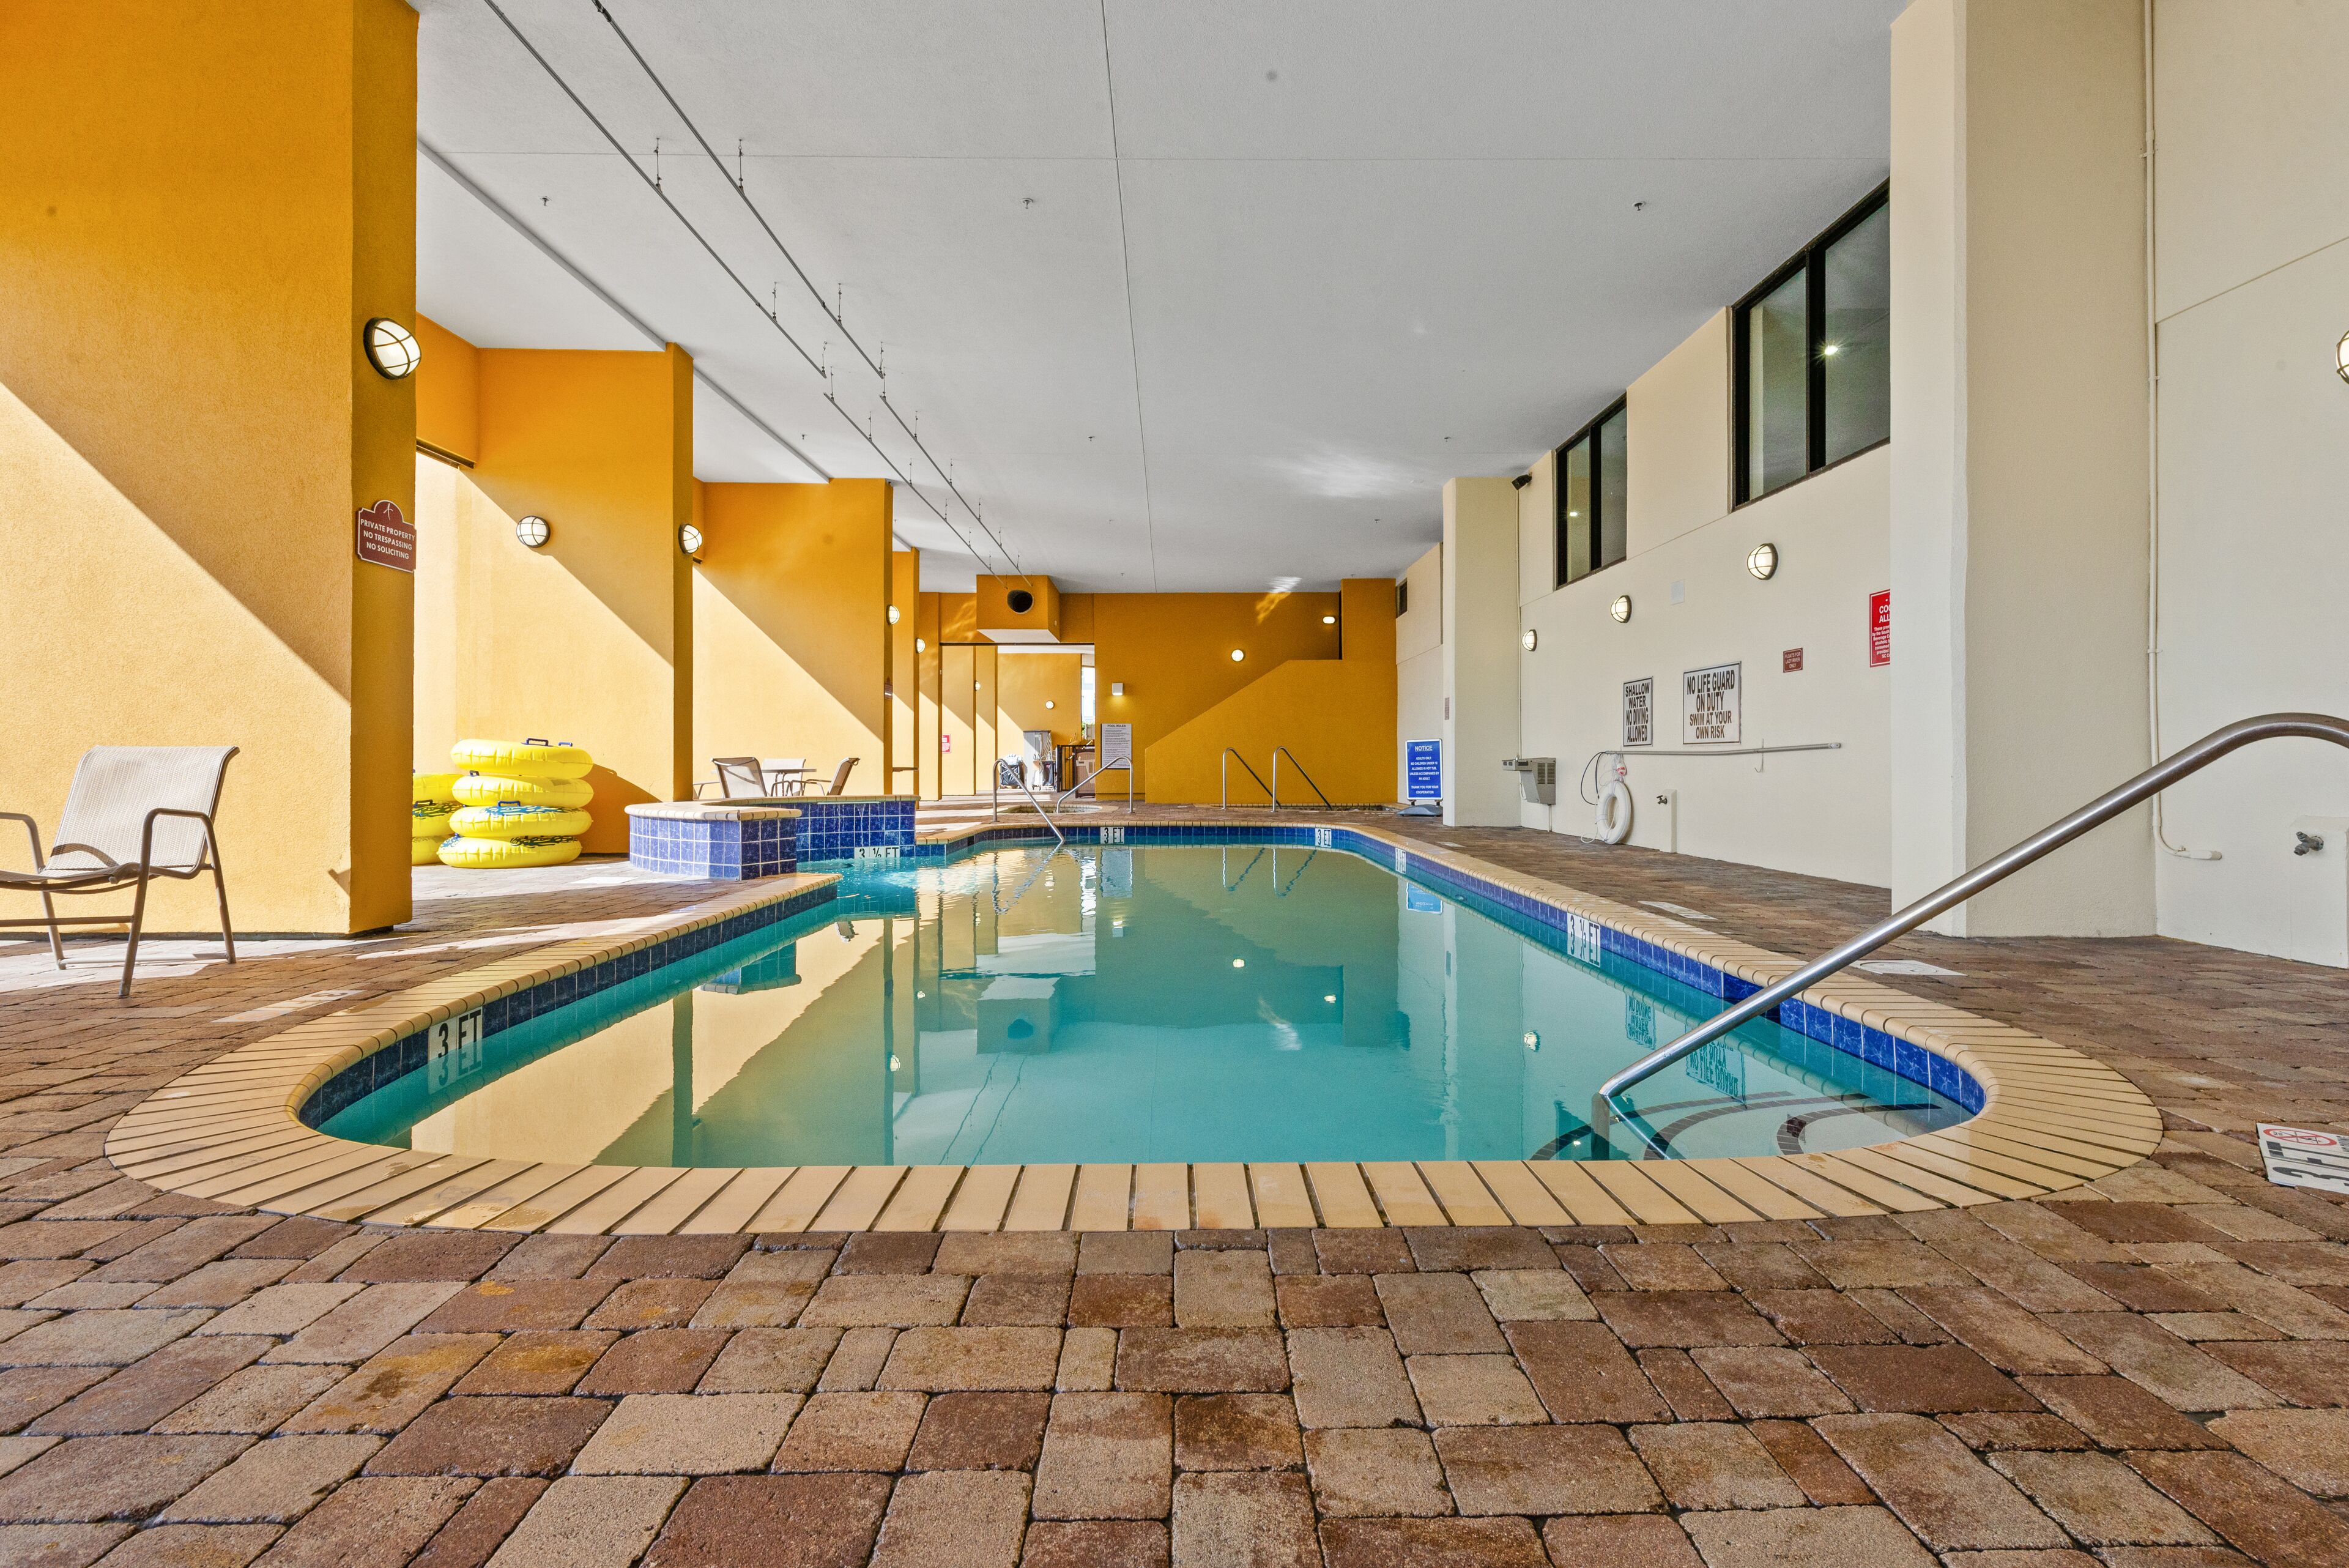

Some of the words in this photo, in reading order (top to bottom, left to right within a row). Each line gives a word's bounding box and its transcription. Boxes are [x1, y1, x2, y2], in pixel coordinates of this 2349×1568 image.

[361, 519, 385, 532] PRIVATE
[387, 527, 415, 541] PROPERTY
[363, 530, 373, 539] NO
[374, 533, 412, 550] TRESPASSING
[377, 544, 409, 559] SOLICITING
[1625, 683, 1650, 697] SHALLOW
[1687, 676, 1695, 695] NO
[1698, 674, 1710, 693] LIFE
[1712, 670, 1735, 691] GUARD
[1628, 696, 1646, 708] WATER
[1696, 694, 1705, 712] ON
[1707, 691, 1724, 712] DUTY
[1627, 710, 1632, 726] NO
[1633, 707, 1649, 725] DIVING
[1690, 713, 1704, 726] SWIM
[1706, 712, 1713, 725] AT
[1715, 711, 1732, 724] YOUR
[1627, 725, 1647, 742] ALLOWED
[1696, 726, 1709, 739] OWN
[1710, 726, 1724, 738] RISK
[859, 848, 865, 859] 3
[886, 847, 899, 858] FT
[438, 1023, 449, 1058] 3
[459, 1009, 481, 1050] FT
